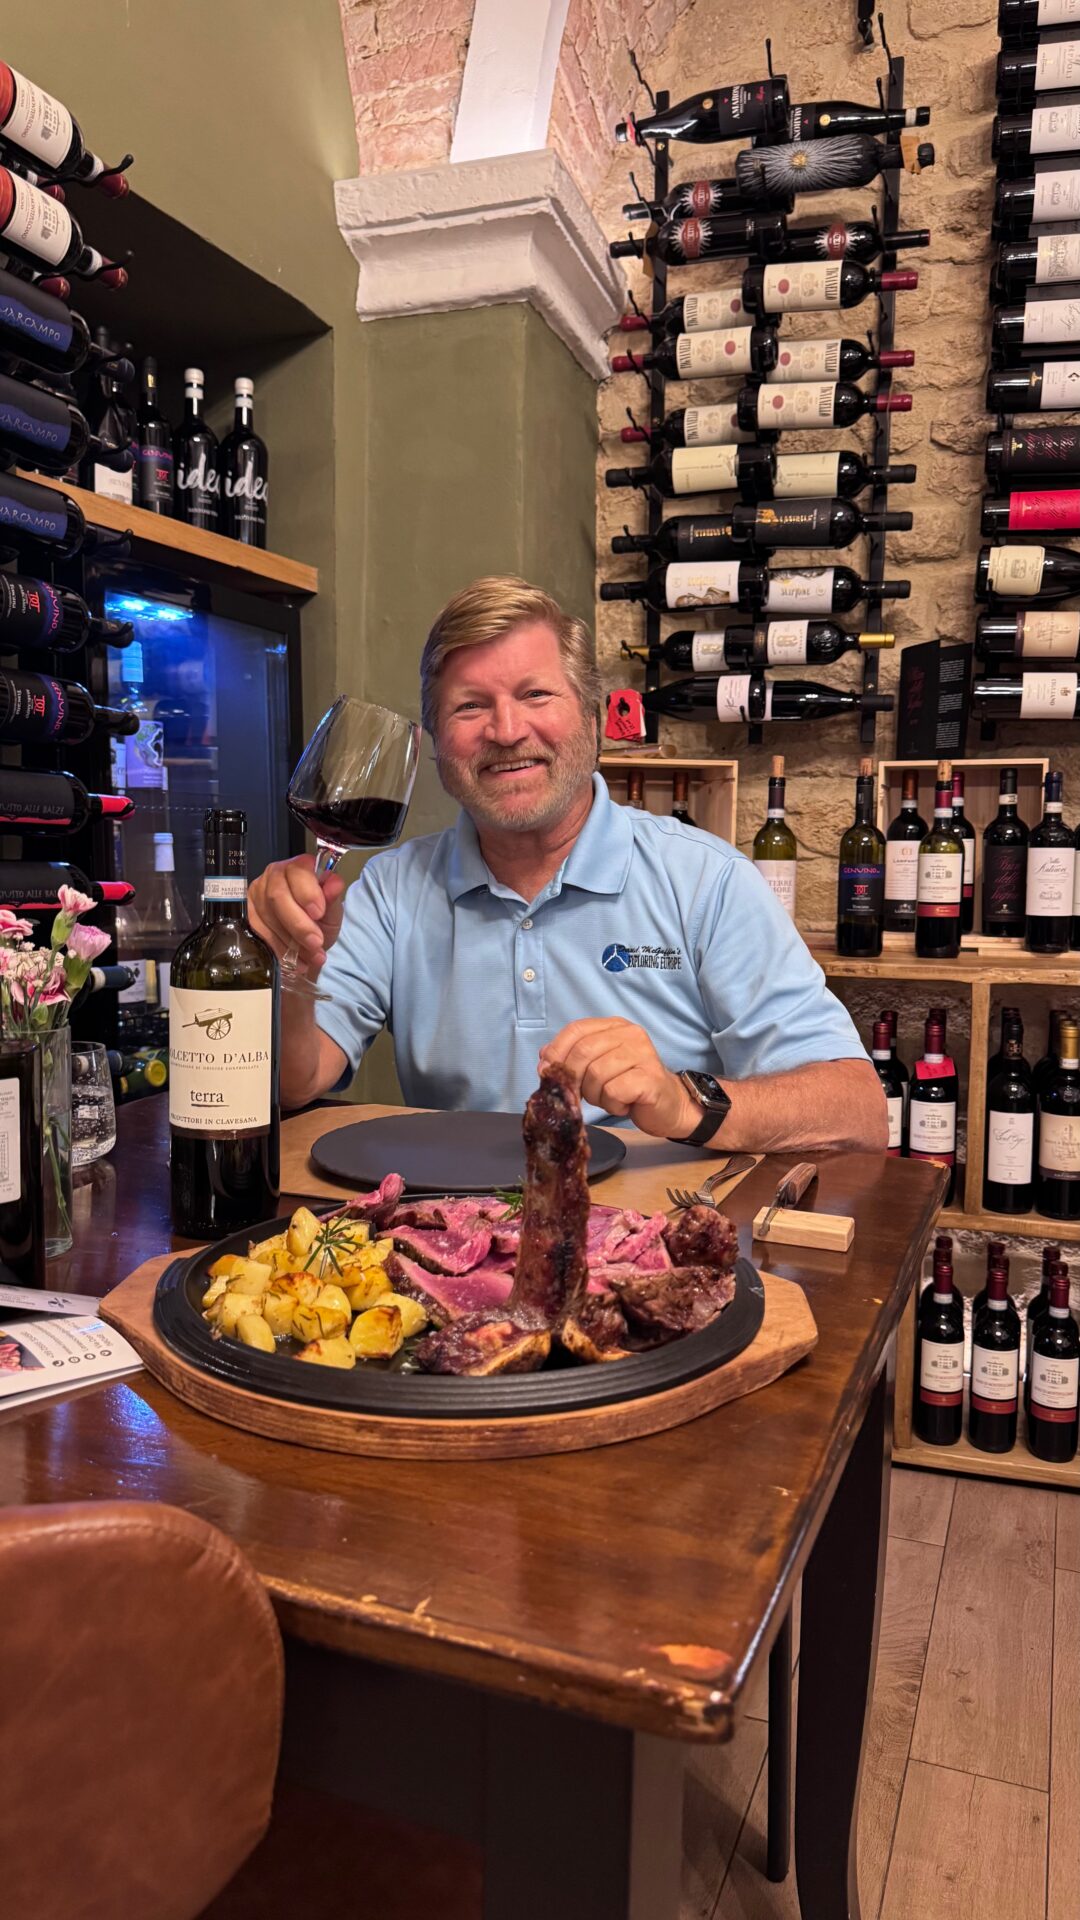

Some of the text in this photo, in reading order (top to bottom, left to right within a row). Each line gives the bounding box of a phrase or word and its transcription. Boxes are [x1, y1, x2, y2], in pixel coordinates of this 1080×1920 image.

[628, 955, 682, 970] EXPLORING EUROPE
[223, 1051, 269, 1064] D'ALBA
[190, 1090, 224, 1103] terra
[204, 1117, 213, 1125] IN
[215, 1116, 258, 1125] CLAVESANA
